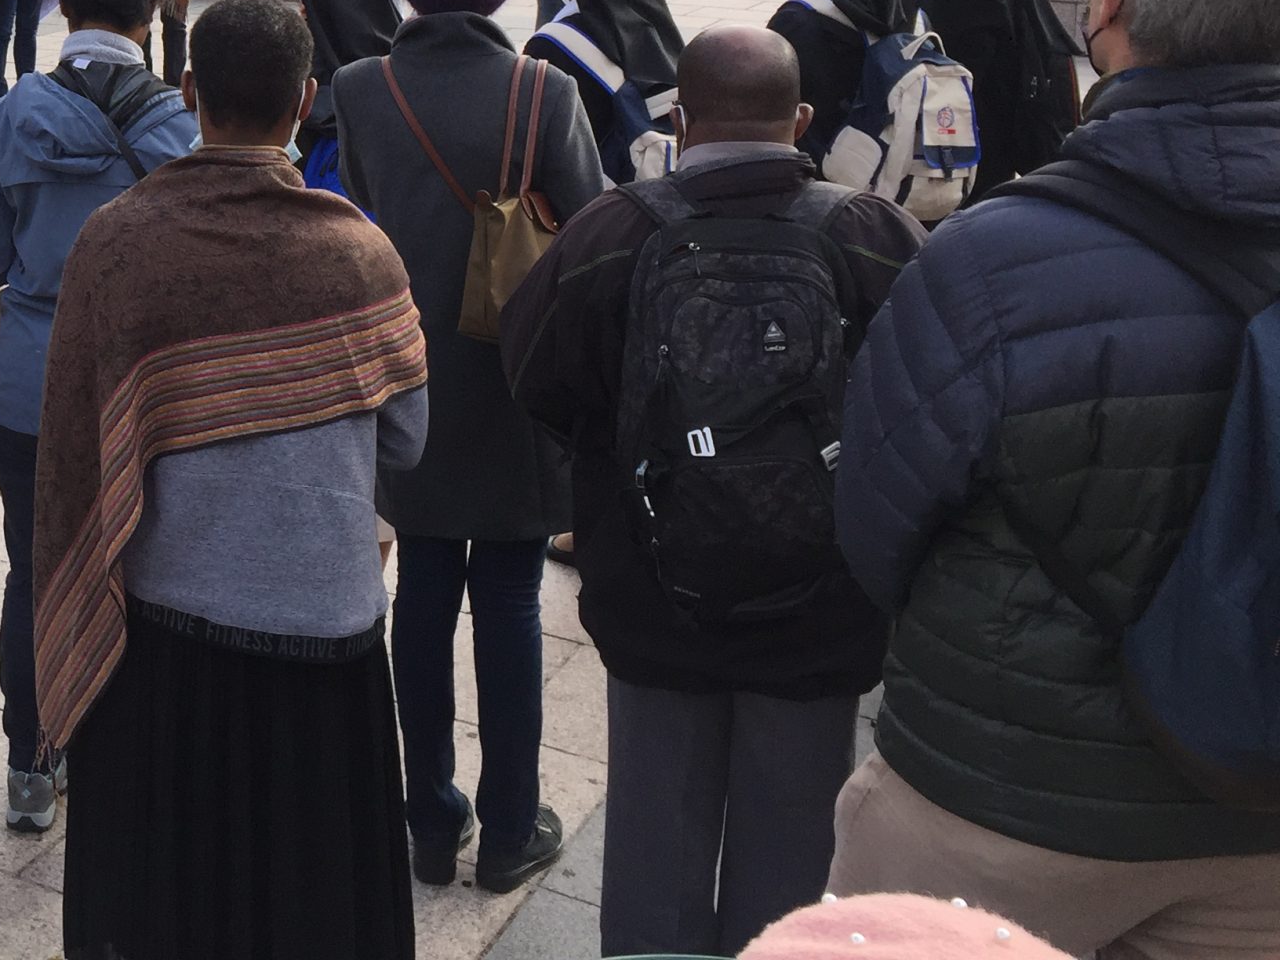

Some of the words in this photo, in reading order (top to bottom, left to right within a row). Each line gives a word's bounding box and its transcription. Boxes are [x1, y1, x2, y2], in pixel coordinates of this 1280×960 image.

[141, 602, 196, 635] ACTIVE
[206, 621, 274, 653] FITNESS
[277, 635, 339, 658] ACTIVE
